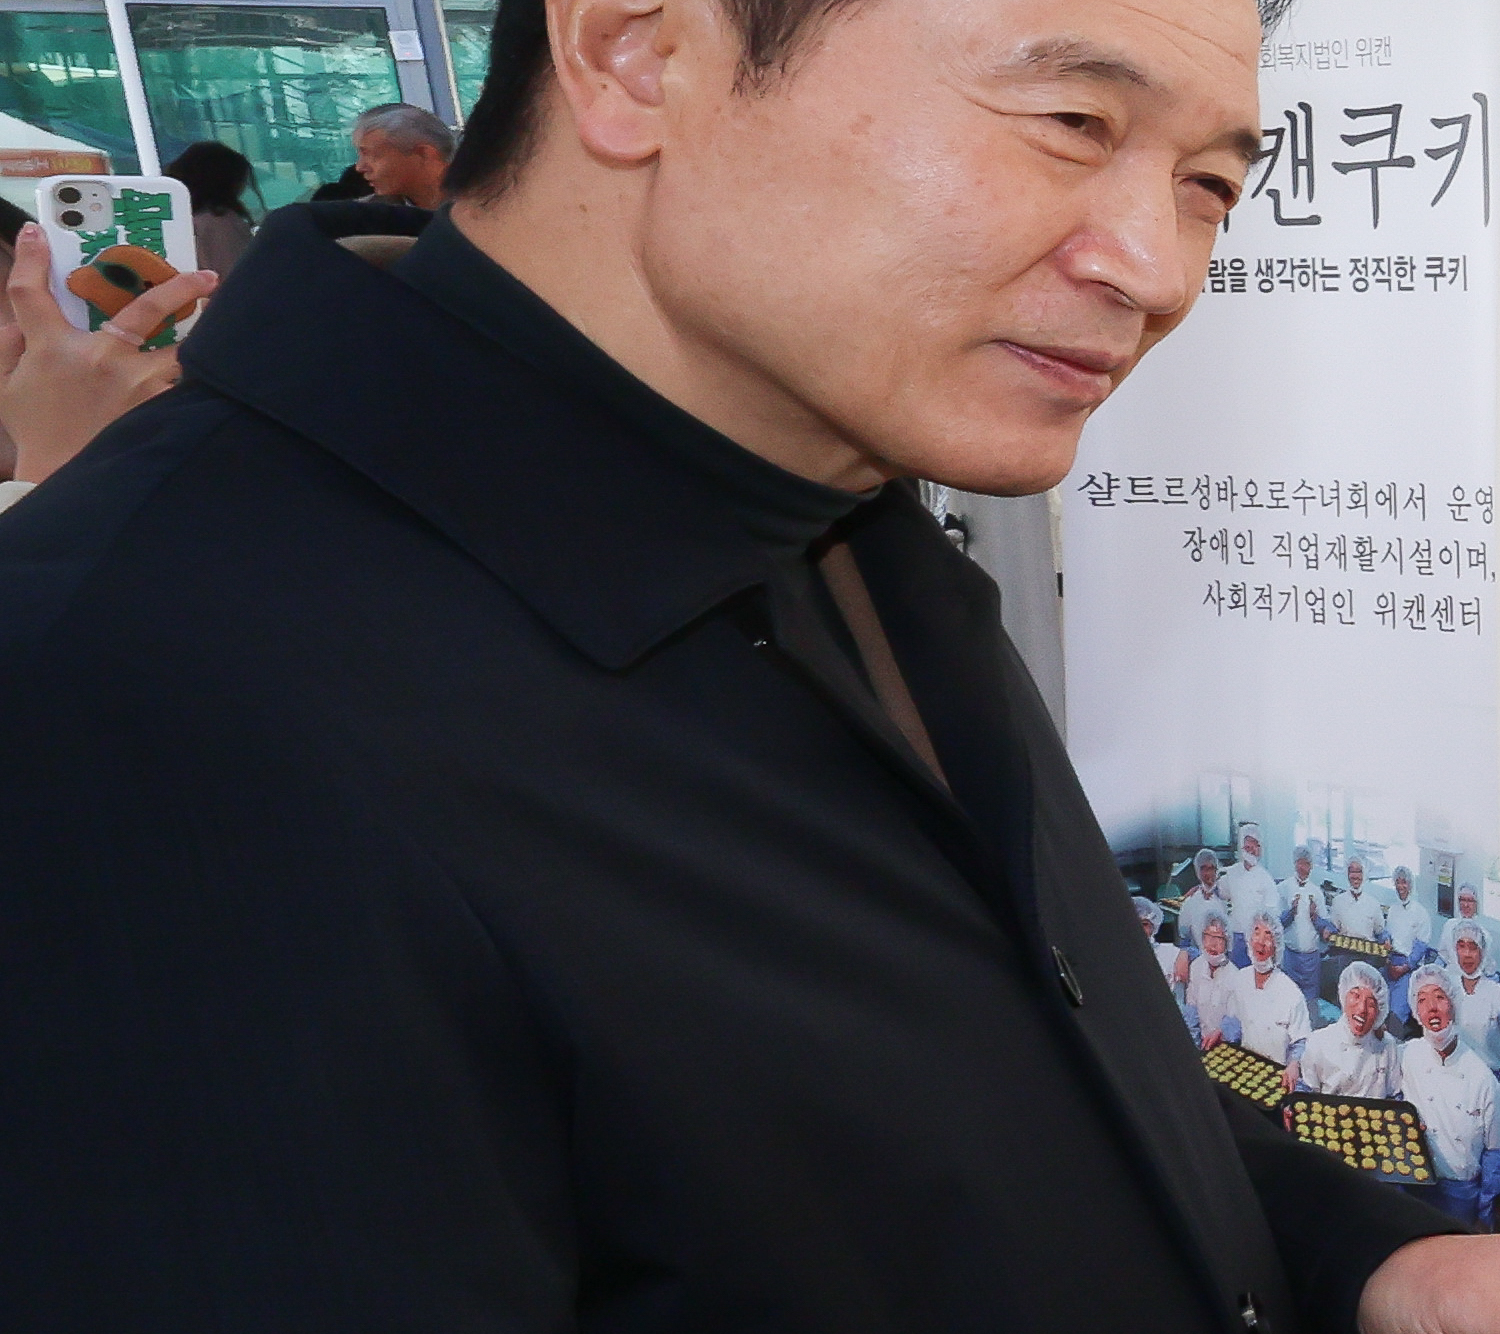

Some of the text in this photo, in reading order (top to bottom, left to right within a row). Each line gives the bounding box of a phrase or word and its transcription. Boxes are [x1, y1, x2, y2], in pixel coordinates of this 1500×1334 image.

[1355, 36, 1392, 67] 위캔
[1222, 92, 1491, 233] 캔쿠키
[1202, 254, 1469, 294] 람을 생각하는 정직한 쿠키
[1446, 483, 1495, 525] 운영
[1182, 526, 1497, 583] 장애인 직업재활시설이며,
[1202, 579, 1481, 636] 사회적기업인 위캔센터
